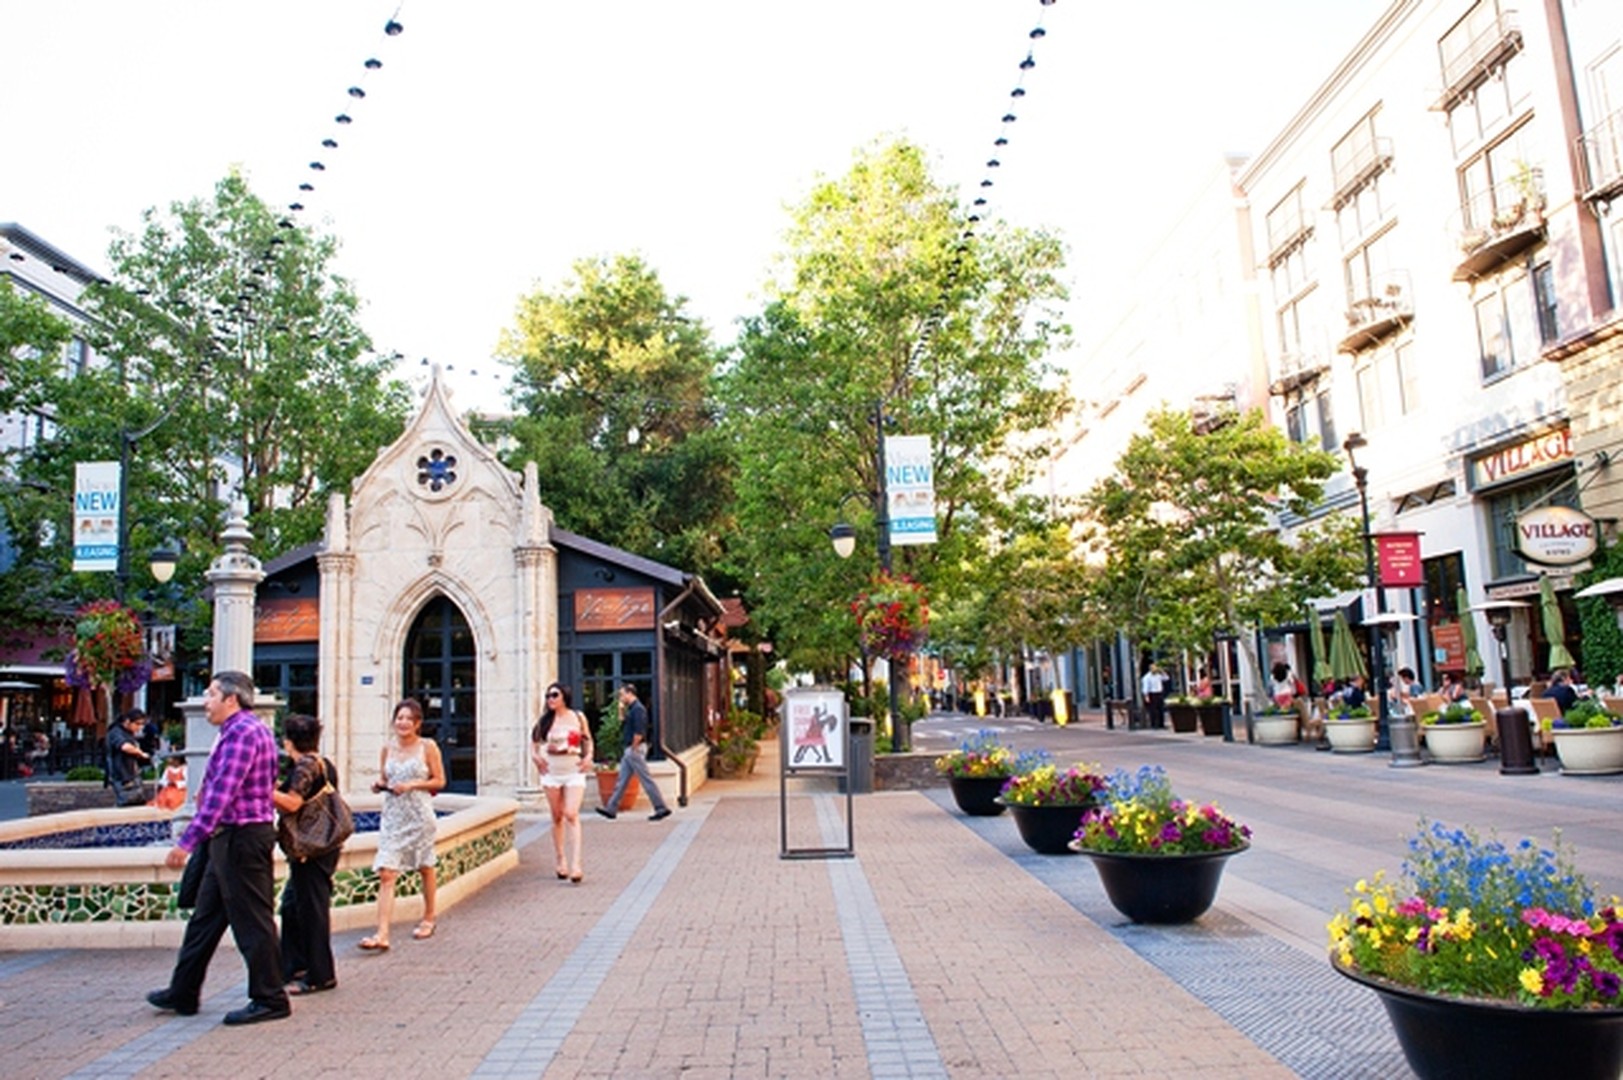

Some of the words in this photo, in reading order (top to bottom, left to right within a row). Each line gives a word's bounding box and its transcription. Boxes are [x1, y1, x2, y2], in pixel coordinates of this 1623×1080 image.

[1482, 428, 1573, 481] VILLAGE
[888, 465, 931, 484] NEW
[76, 491, 117, 510] NEW
[1521, 523, 1593, 539] VILLAGE
